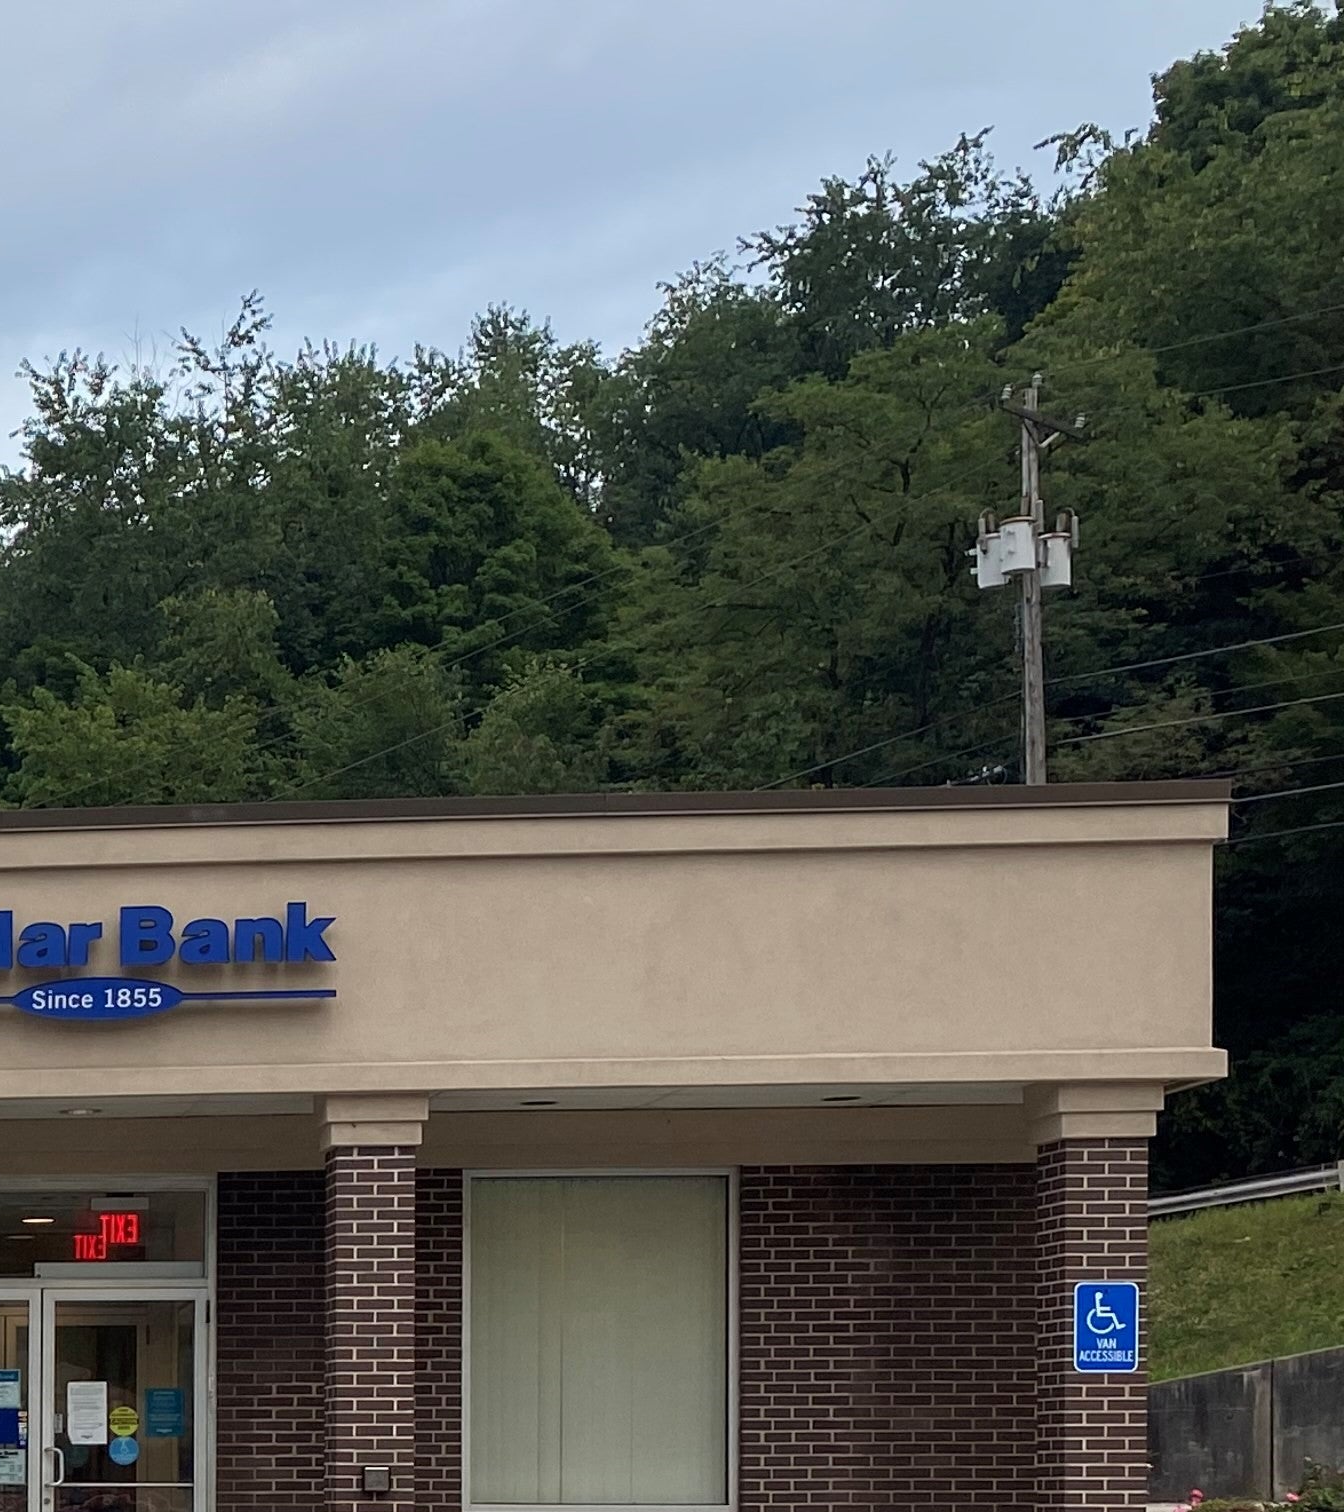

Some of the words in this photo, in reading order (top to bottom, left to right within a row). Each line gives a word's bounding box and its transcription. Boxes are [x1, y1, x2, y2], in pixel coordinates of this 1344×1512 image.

[119, 901, 337, 967] Bank
[31, 989, 94, 1010] Since
[103, 988, 163, 1009] 1855
[1096, 1337, 1117, 1350] VAN
[1079, 1350, 1134, 1362] ACCESSIBLE
